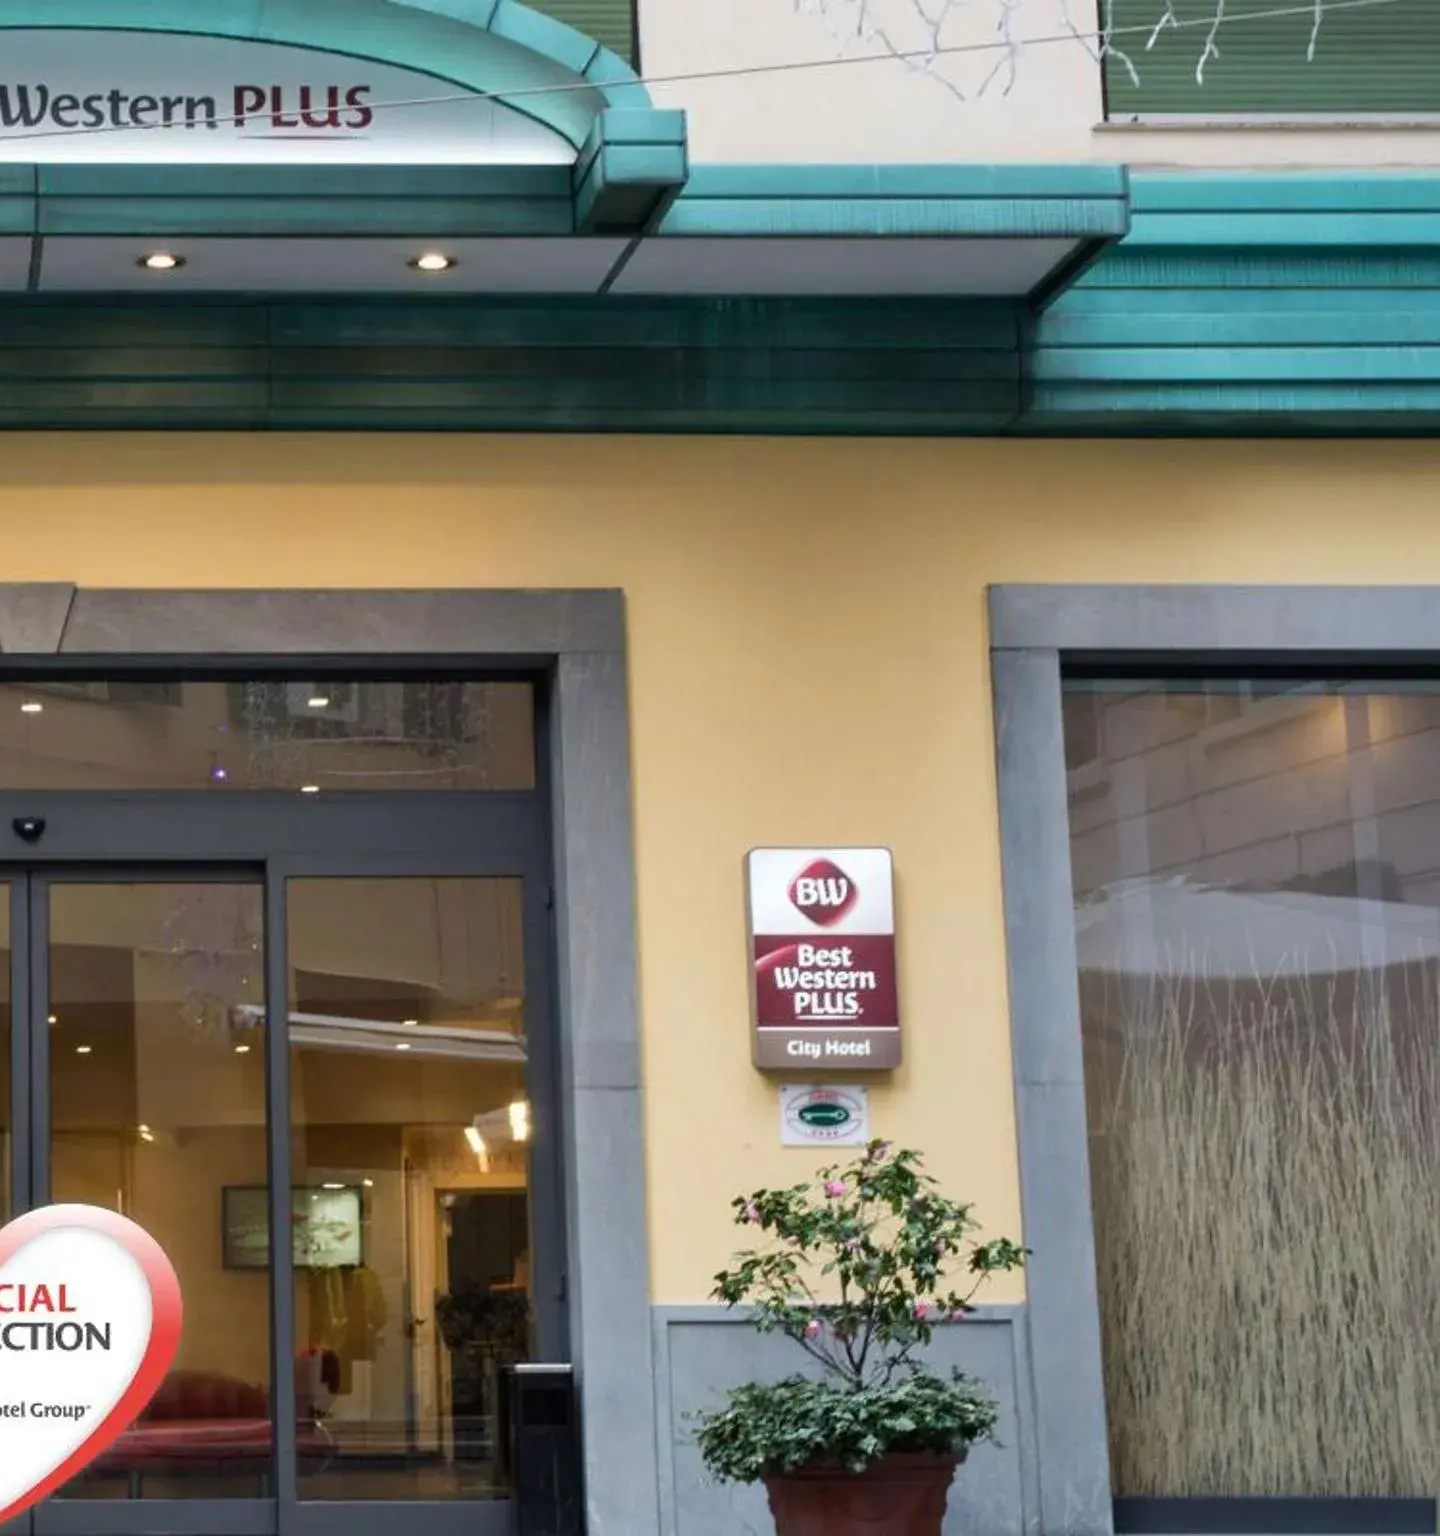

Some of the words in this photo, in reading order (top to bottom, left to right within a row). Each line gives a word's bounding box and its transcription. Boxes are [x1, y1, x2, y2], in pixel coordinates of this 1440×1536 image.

[233, 84, 373, 129] PLUS
[796, 878, 848, 906] BW
[797, 943, 854, 968] Best
[774, 966, 877, 990] Western
[786, 1039, 822, 1059] City
[824, 1038, 872, 1056] Hotel
